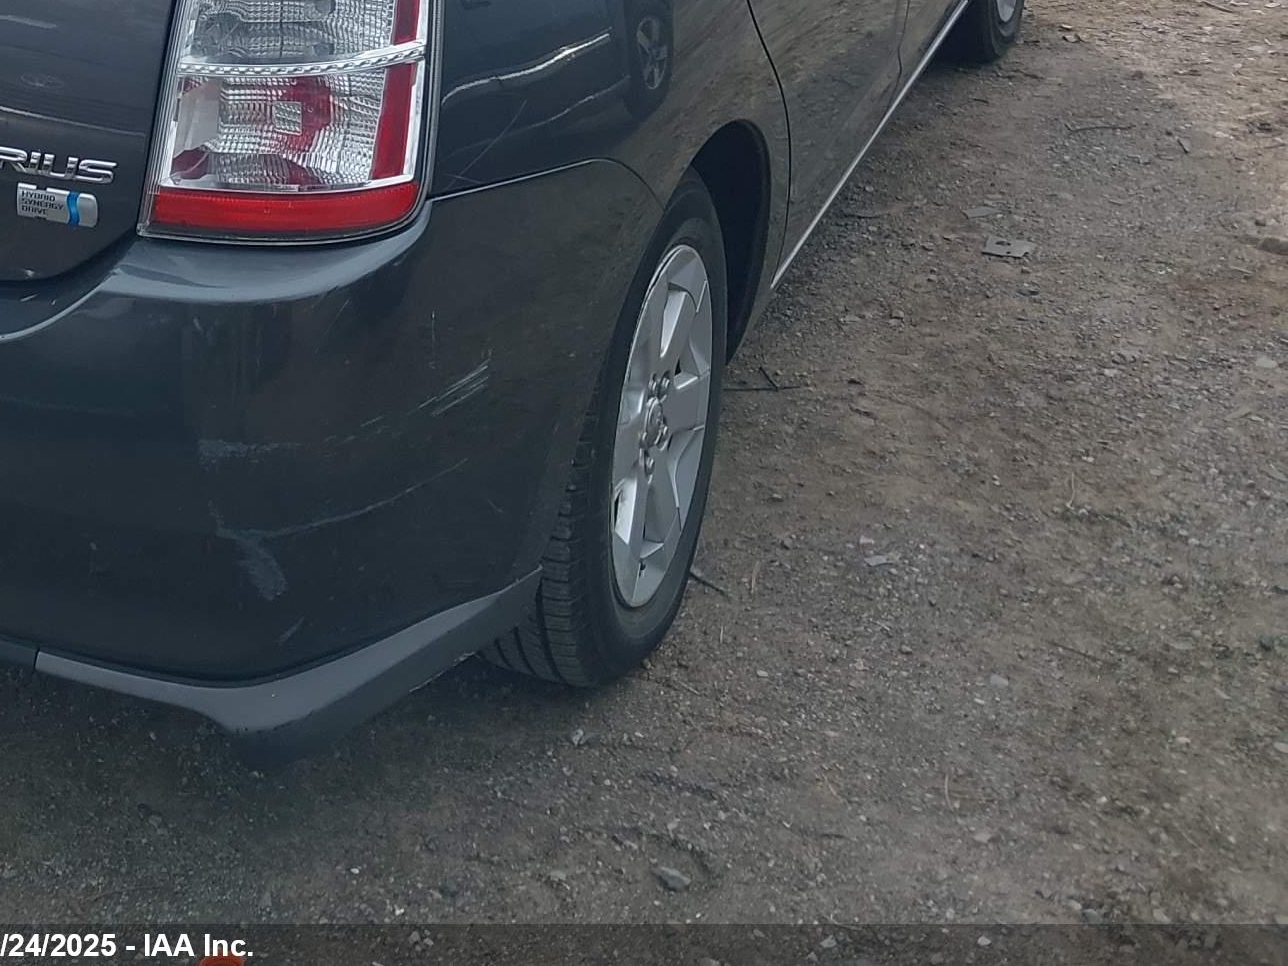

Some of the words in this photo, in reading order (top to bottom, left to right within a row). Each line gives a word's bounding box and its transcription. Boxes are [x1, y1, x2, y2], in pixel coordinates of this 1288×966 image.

[21, 190, 56, 202] HYBRID
[21, 197, 64, 210] SYNERGY
[21, 205, 49, 215] DRIVE
